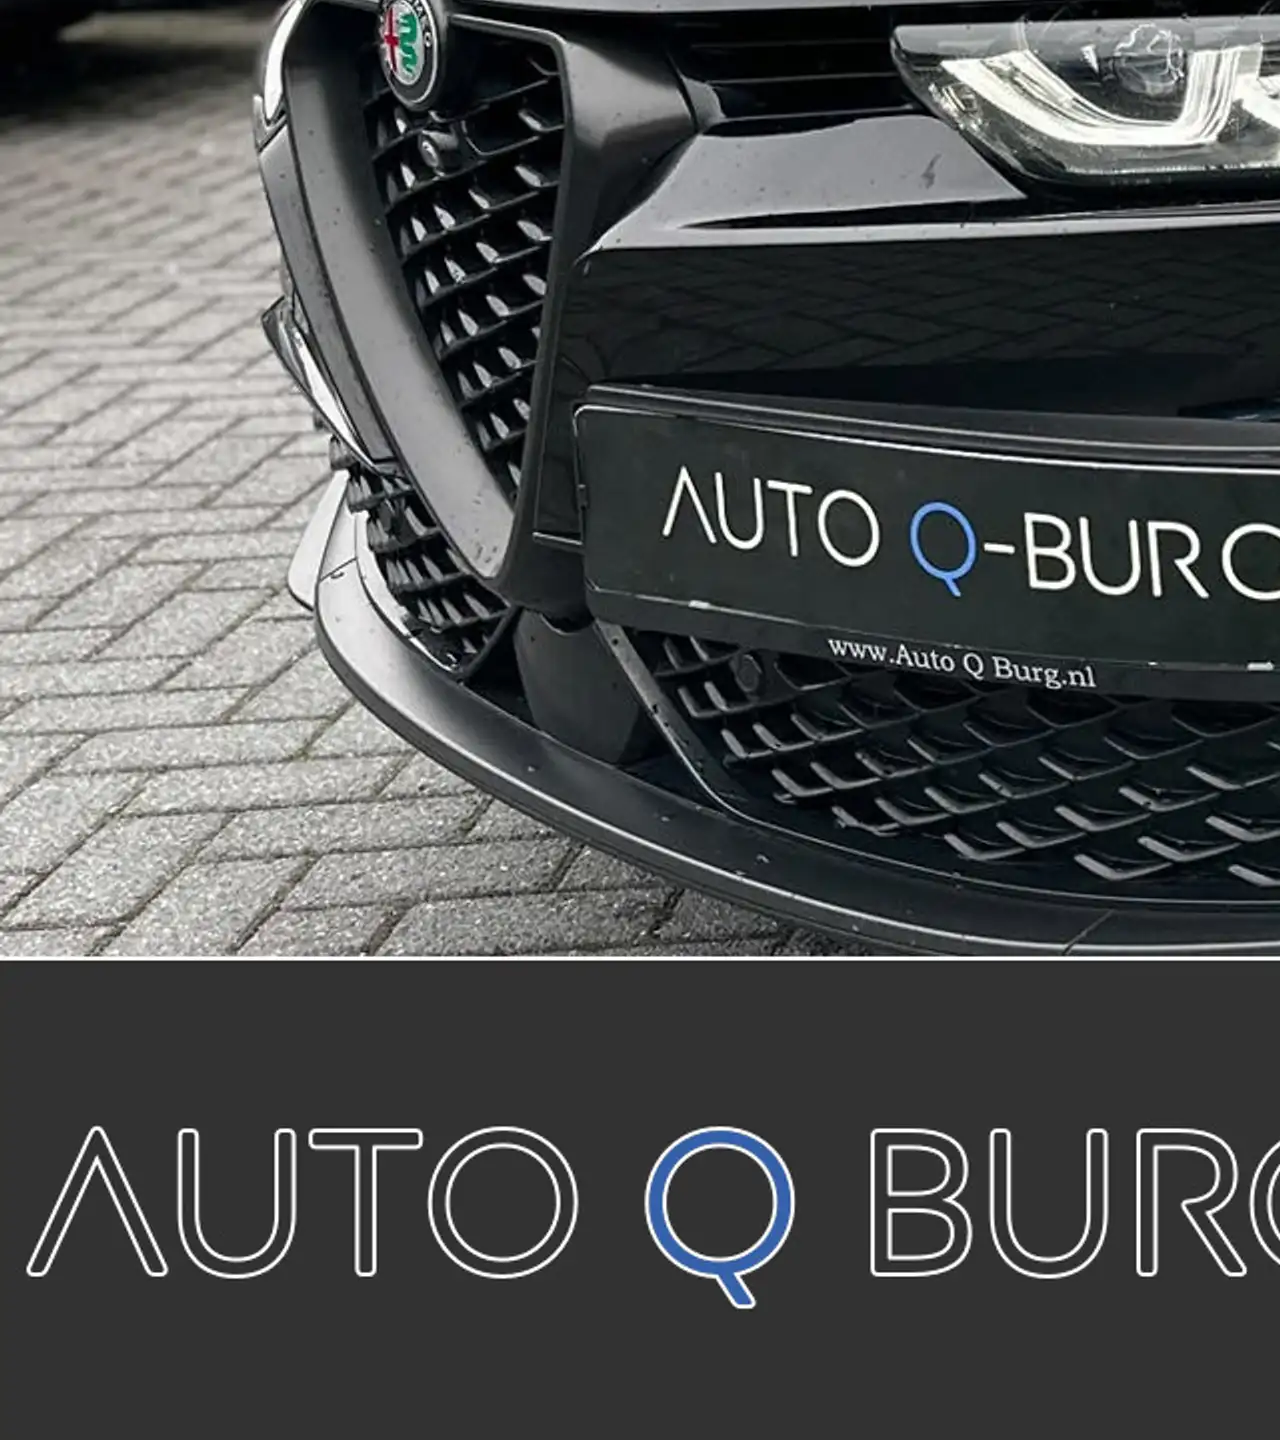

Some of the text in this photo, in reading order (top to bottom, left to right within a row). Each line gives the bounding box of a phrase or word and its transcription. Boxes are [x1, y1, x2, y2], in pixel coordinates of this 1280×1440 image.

[662, 465, 881, 568] AUTO
[827, 637, 1098, 690] www.Auto Q Burg.nl
